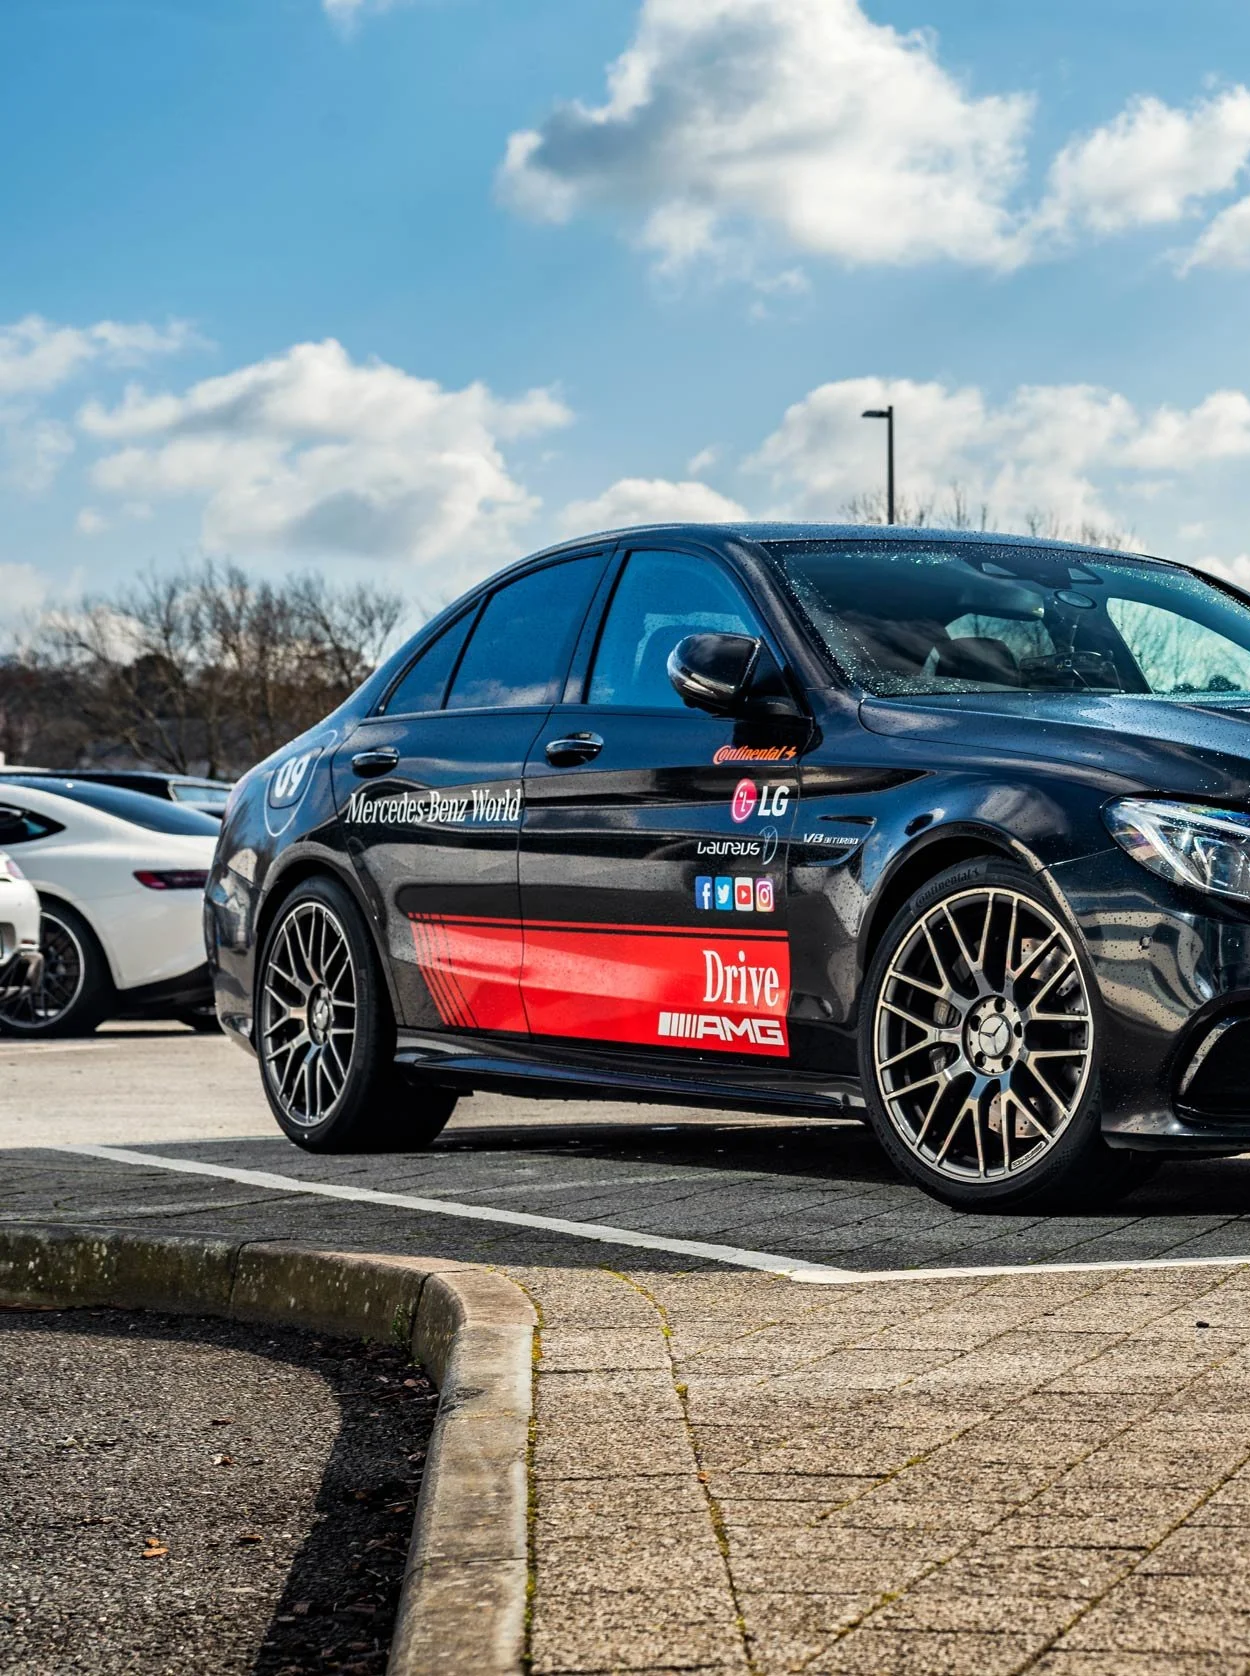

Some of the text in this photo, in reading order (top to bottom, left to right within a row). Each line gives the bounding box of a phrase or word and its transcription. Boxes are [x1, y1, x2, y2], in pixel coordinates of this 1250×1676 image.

[713, 745, 785, 764] Continental
[274, 755, 311, 798] 09
[345, 788, 521, 824] Mercedes-Benz World
[758, 786, 790, 817] LG
[803, 833, 859, 845] V8 BITURBO
[915, 868, 972, 907] Continental
[702, 950, 780, 1007] Drive
[697, 1014, 785, 1046] AMG
